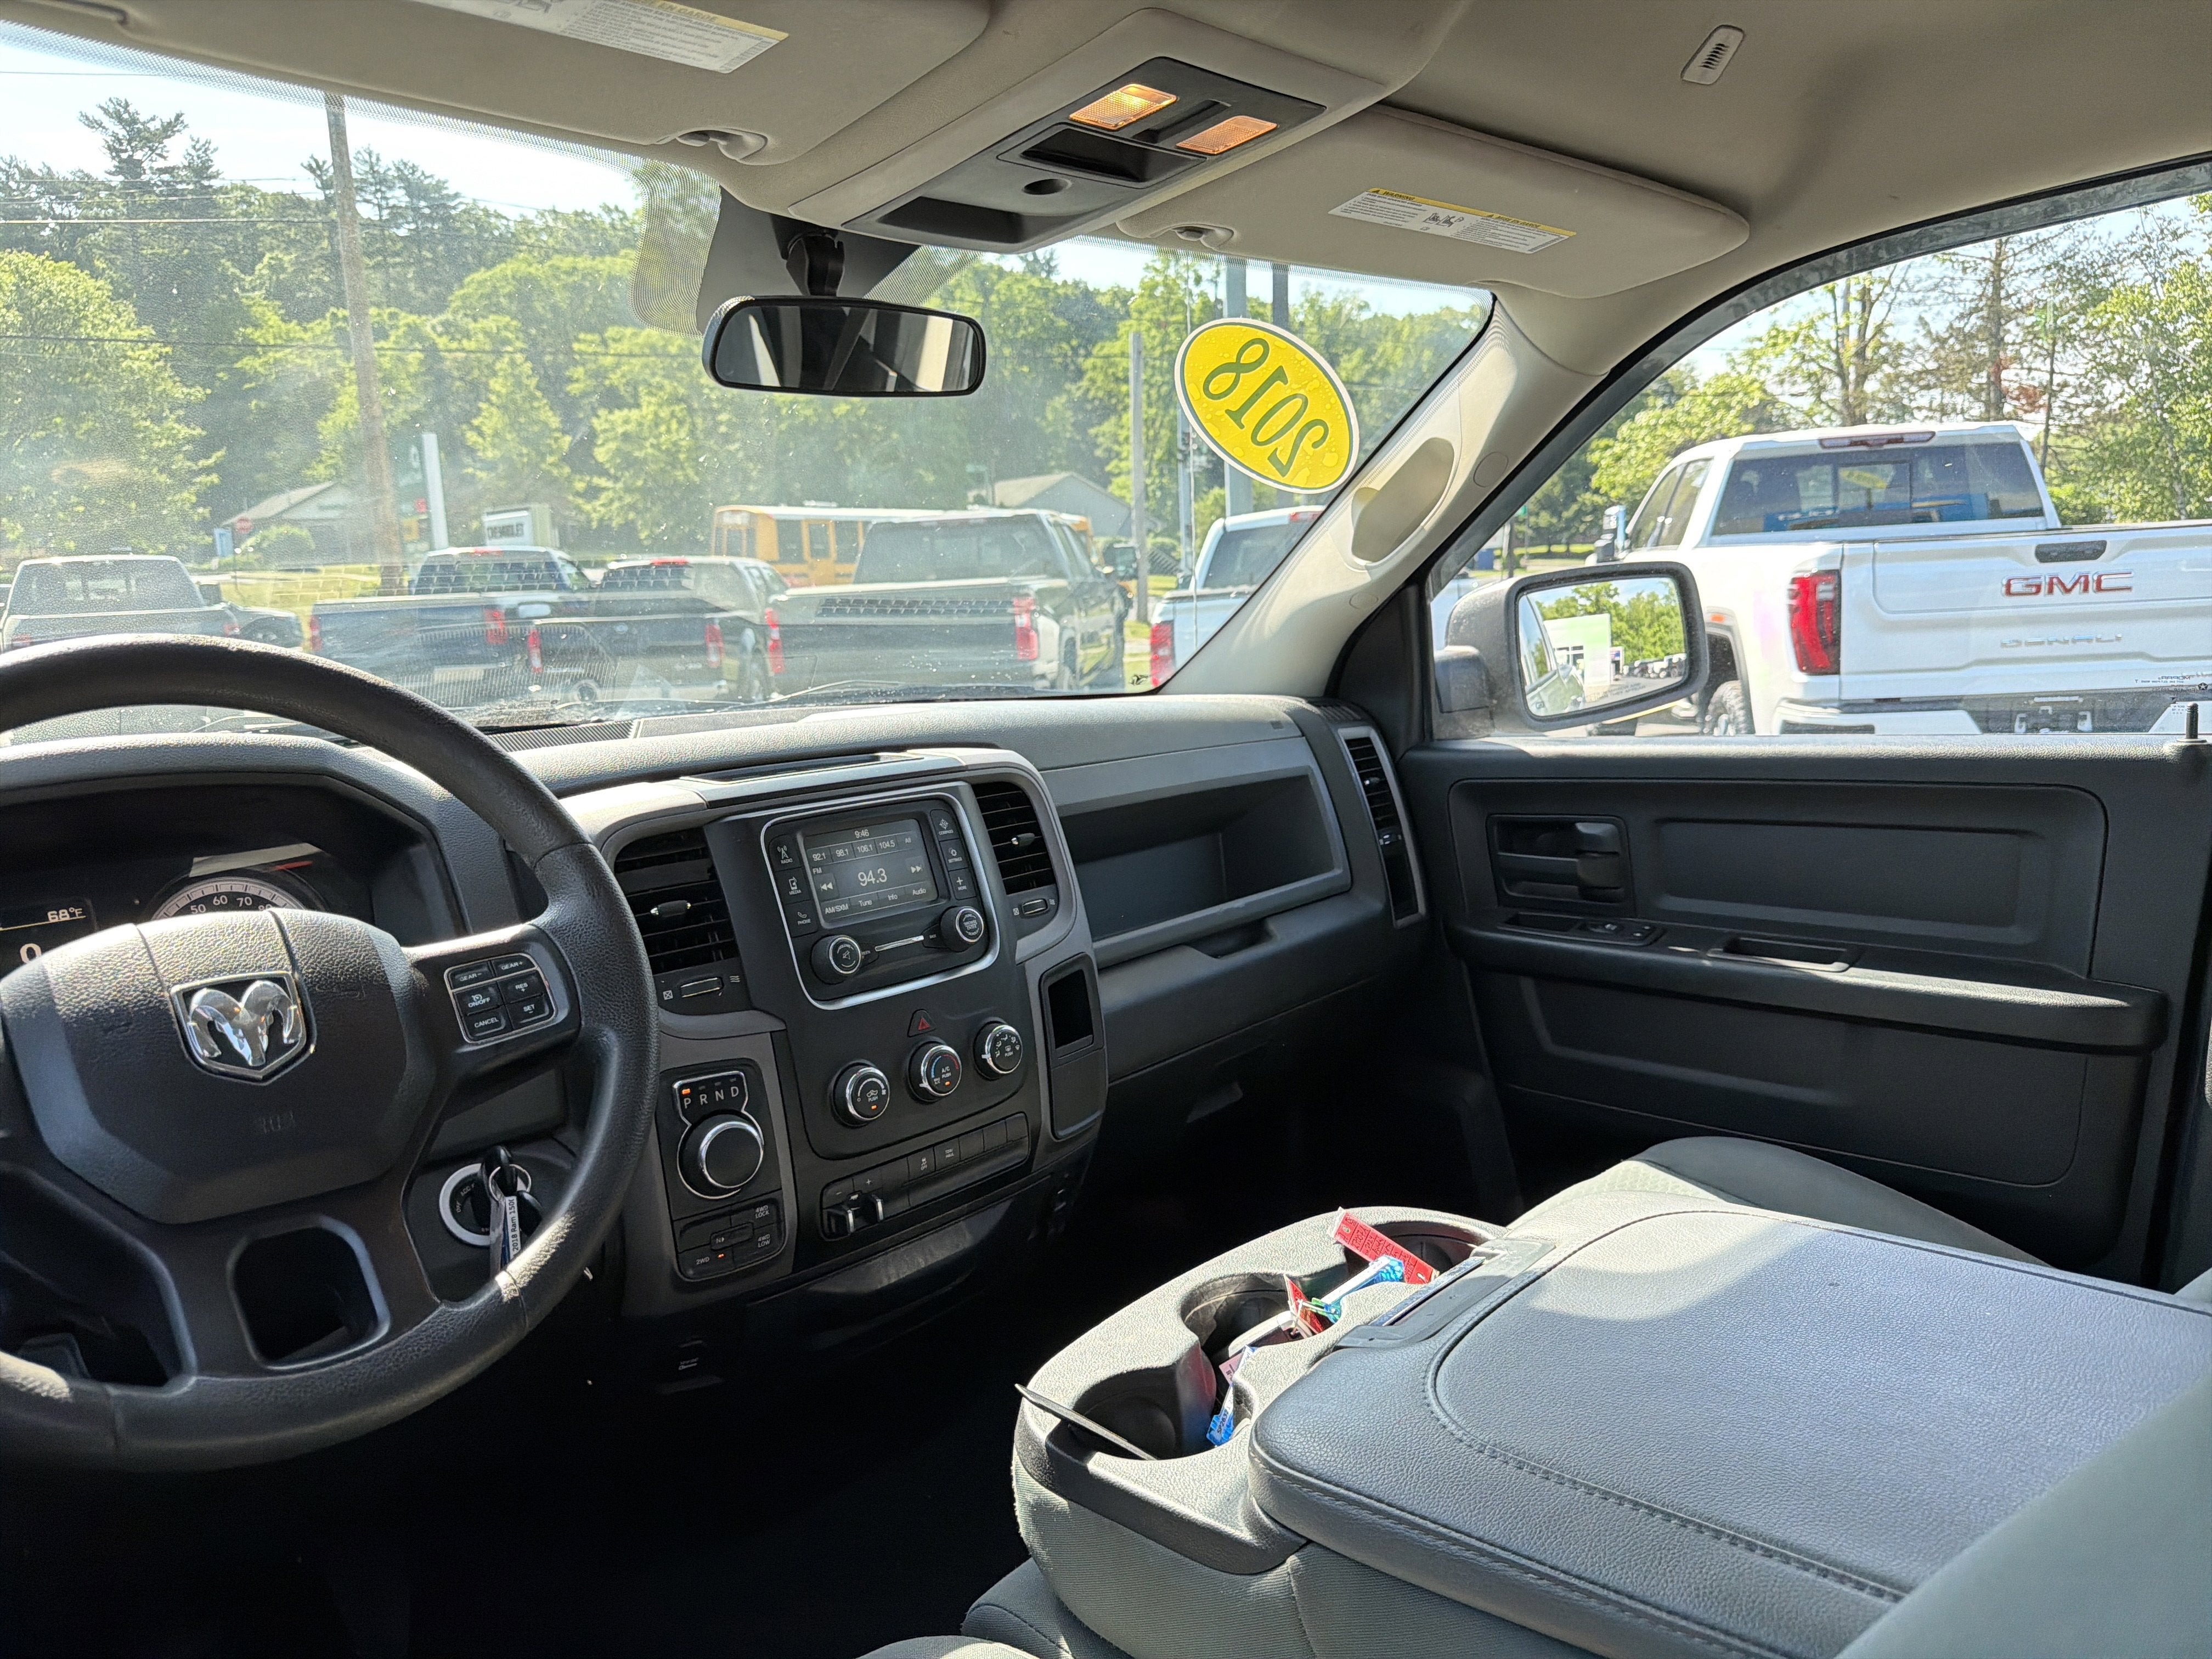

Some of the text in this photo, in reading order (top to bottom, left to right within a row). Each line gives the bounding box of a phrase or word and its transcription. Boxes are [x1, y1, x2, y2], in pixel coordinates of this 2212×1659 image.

[2002, 570, 2134, 596] GMC
[855, 829, 869, 838] 9:46
[812, 852, 826, 861] 92.1
[836, 848, 849, 857] 98.1
[857, 844, 873, 853] 106.1
[879, 839, 895, 849] 104.5
[858, 868, 887, 887] 94.3
[213, 895, 228, 906] 60
[236, 896, 252, 907] 70
[190, 904, 206, 914] 50
[825, 904, 849, 915] AM/SXM
[468, 997, 490, 1008] ON/OFF
[474, 1017, 499, 1028] CANCEL
[684, 1087, 738, 1109] P R N D
[755, 1205, 769, 1213] 4WD
[755, 1211, 769, 1219] LOCK
[758, 1234, 770, 1242] 4WD
[758, 1239, 771, 1248] LOW
[696, 1256, 710, 1265] 2WD
